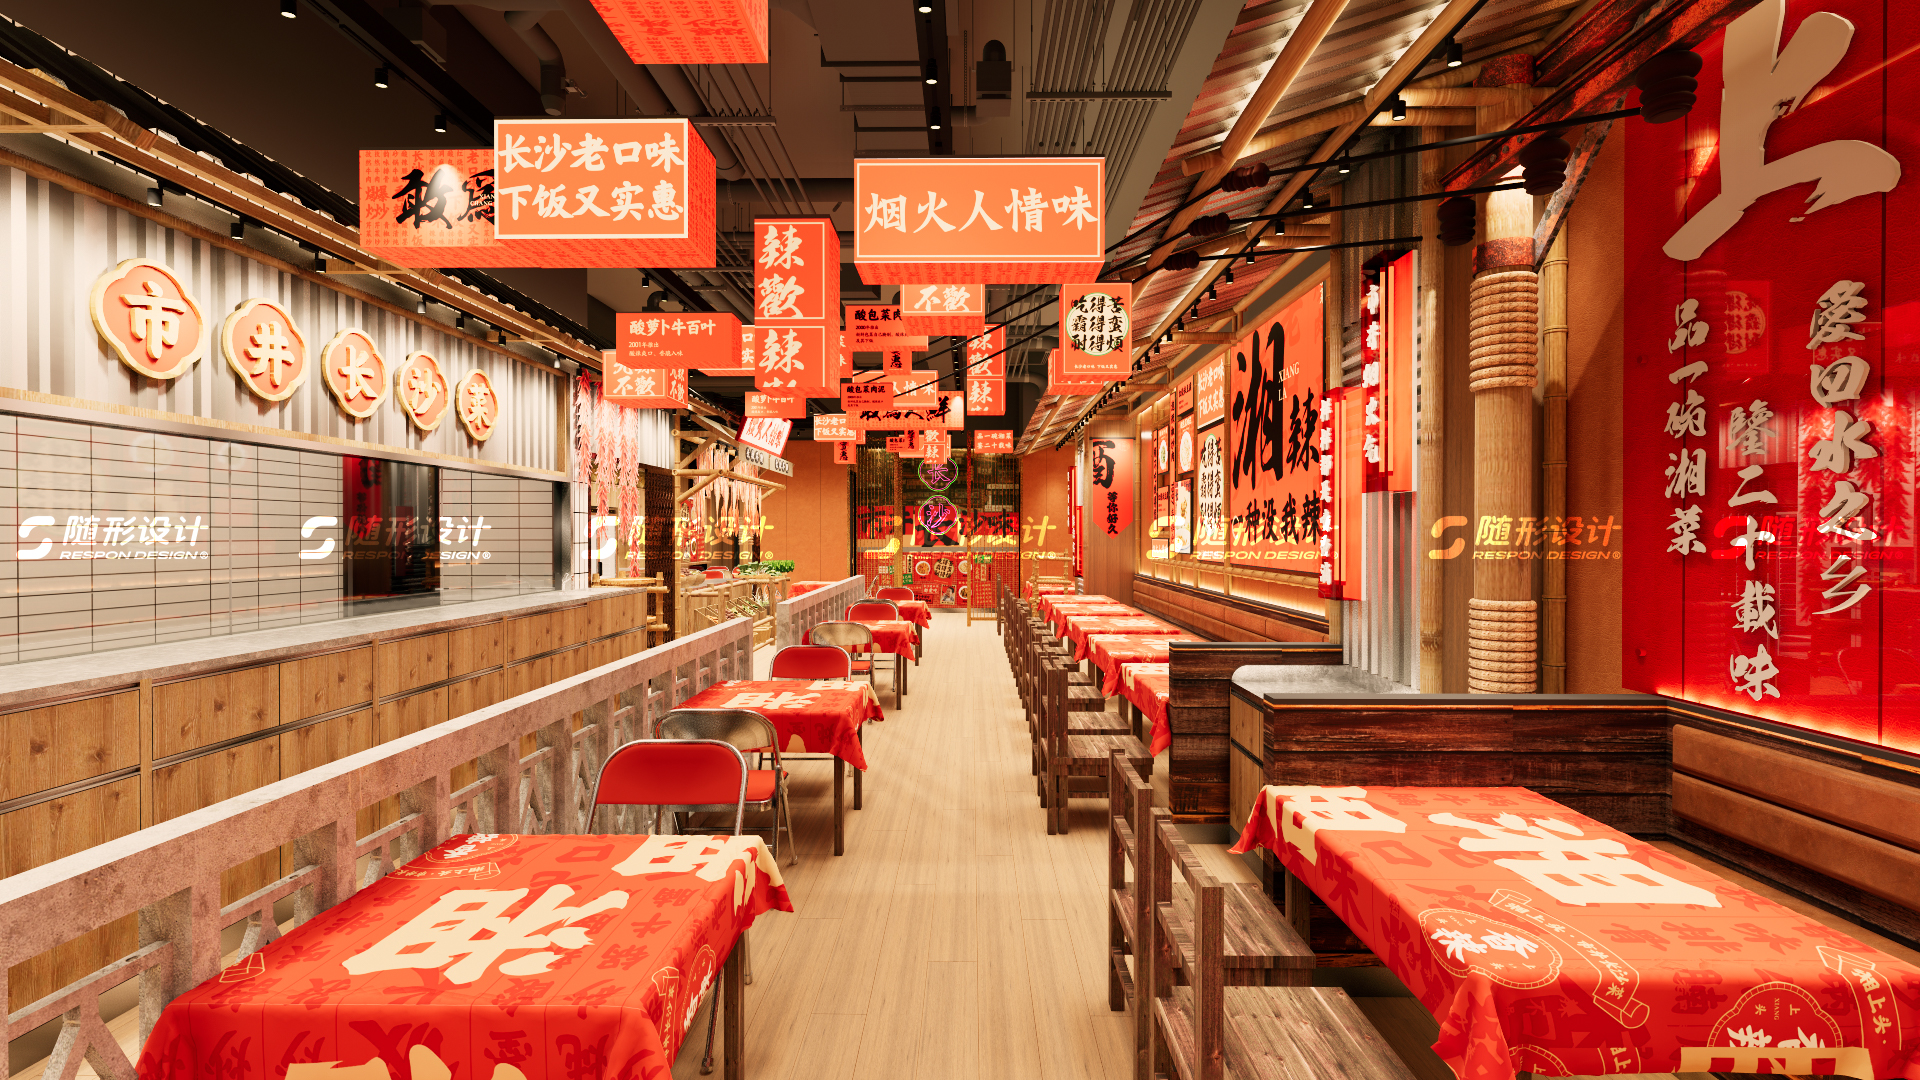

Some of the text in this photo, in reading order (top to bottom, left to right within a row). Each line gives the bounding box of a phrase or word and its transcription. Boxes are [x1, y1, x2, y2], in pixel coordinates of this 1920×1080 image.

[499, 132, 685, 172] 长沙老口味
[499, 180, 685, 221] 下饭又实惠
[863, 185, 1099, 234] 烟火人情味
[1071, 295, 1125, 314] 吃得苦
[629, 318, 716, 336] 酸萝卜牛百叶
[120, 281, 492, 429] 市井长沙菜
[758, 327, 805, 387] 辣
[1278, 361, 1300, 384] XIANG
[847, 385, 885, 393] 酸包菜肉泥
[1278, 389, 1287, 402] LA
[976, 432, 1012, 440] 品一碗湘菜
[1664, 298, 1710, 556] 品一碗湘菜
[1106, 491, 1119, 534] 等你好久
